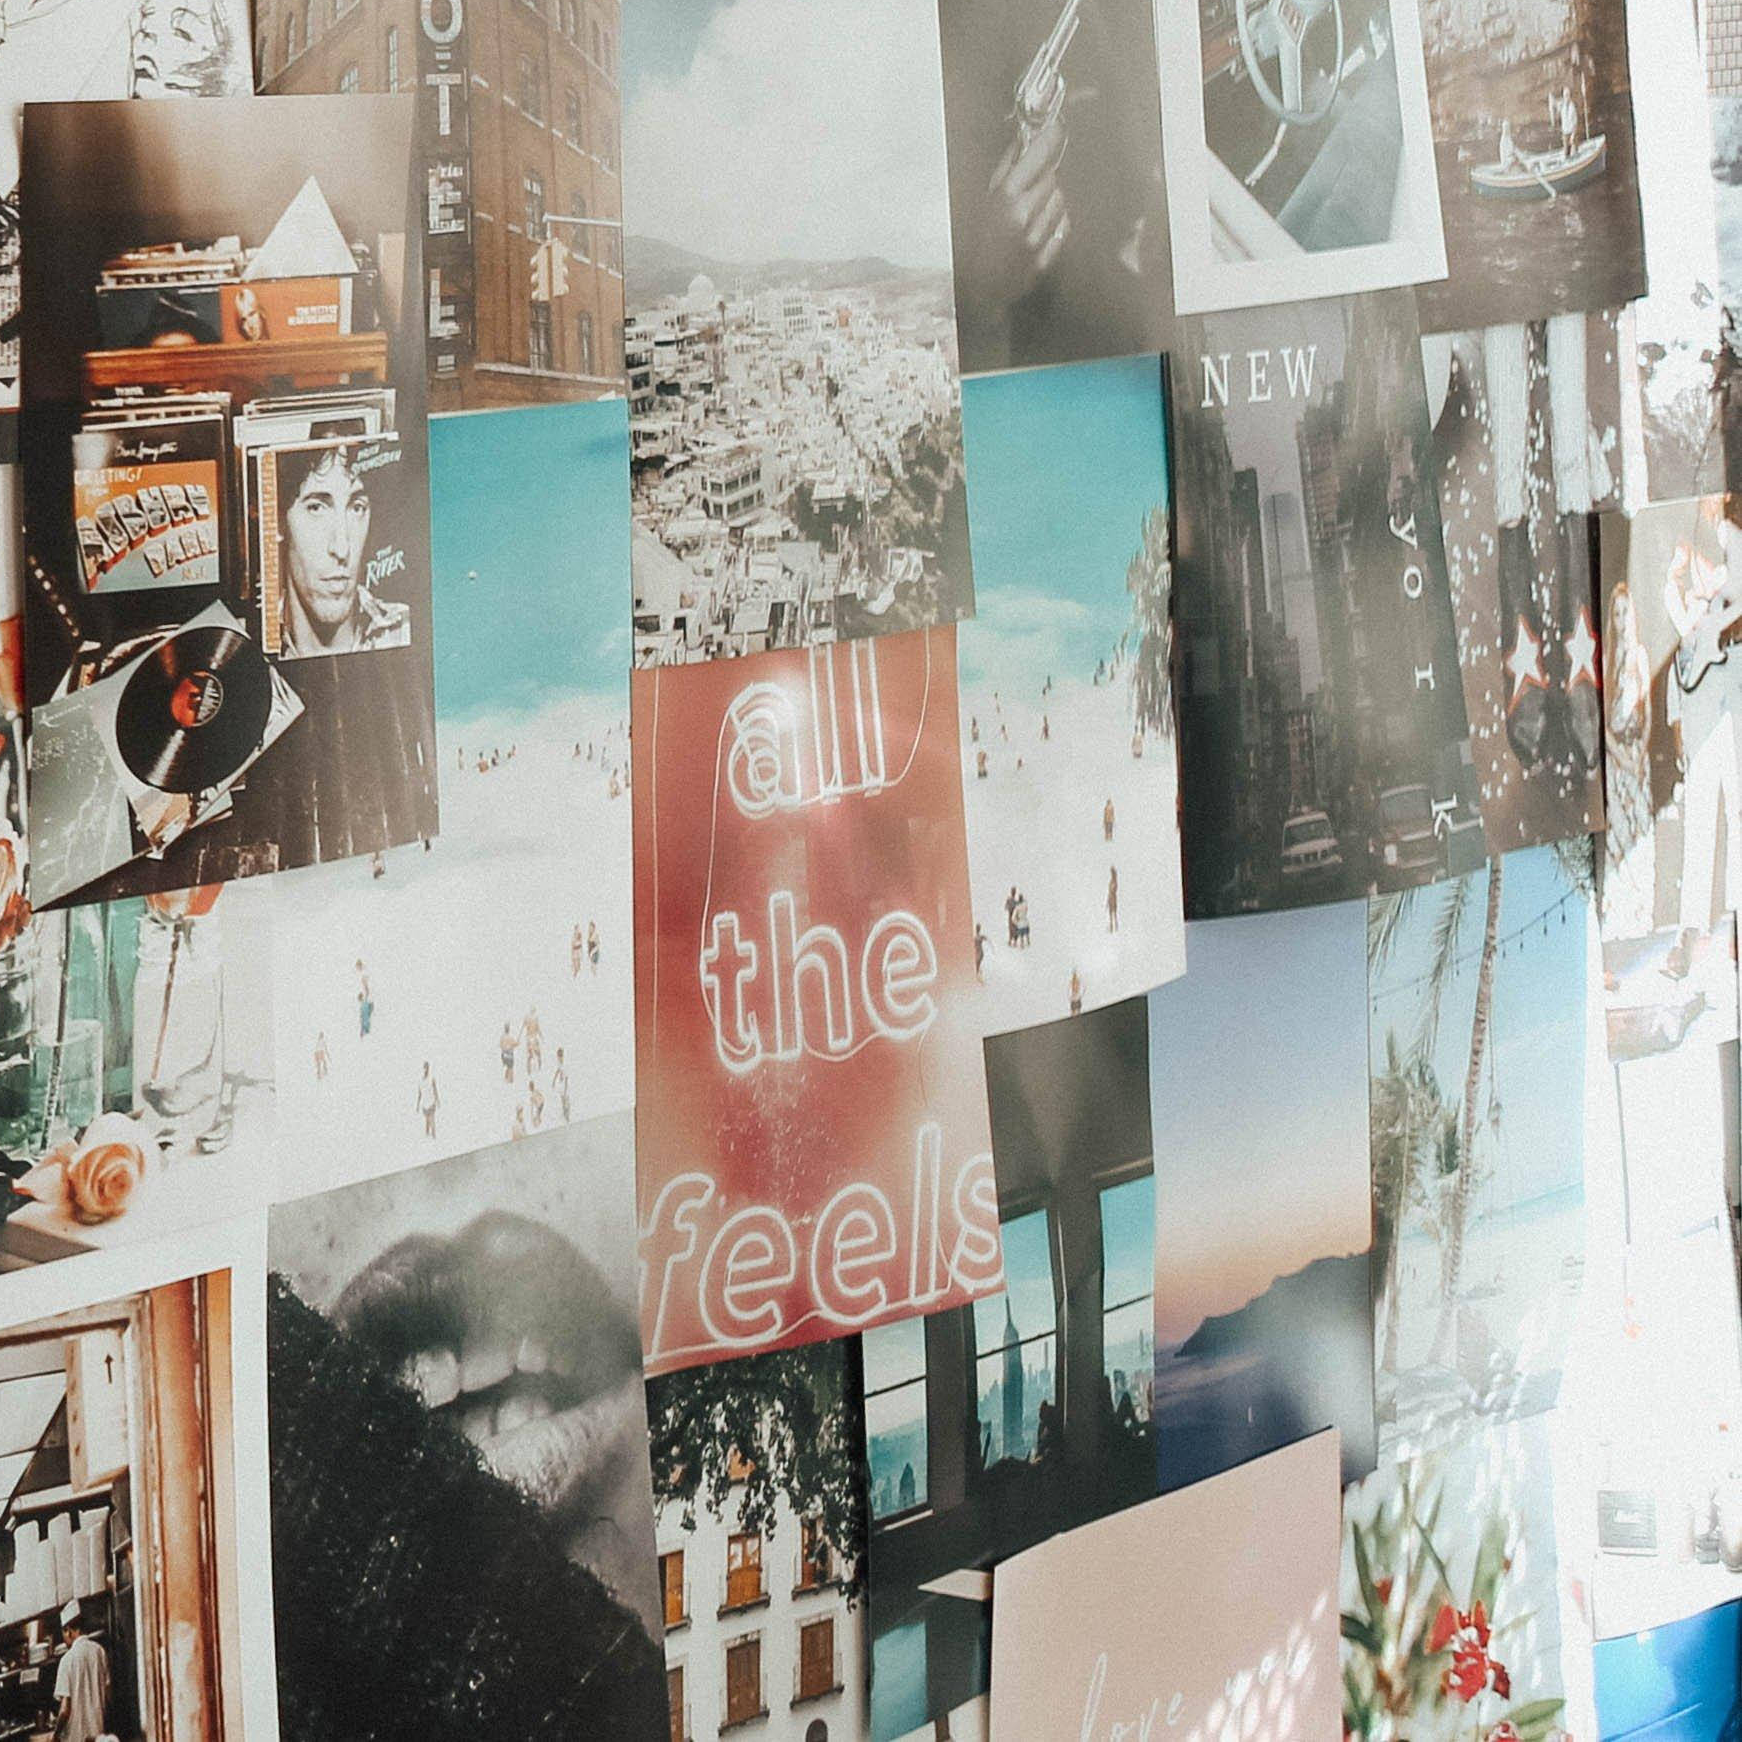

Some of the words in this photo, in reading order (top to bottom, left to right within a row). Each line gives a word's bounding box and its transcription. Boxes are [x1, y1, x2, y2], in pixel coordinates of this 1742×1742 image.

[1200, 344, 1316, 409] NEW
[366, 550, 406, 589] RIVER
[728, 637, 886, 813] all
[700, 890, 938, 1075] the
[636, 1122, 1005, 1362] feels
